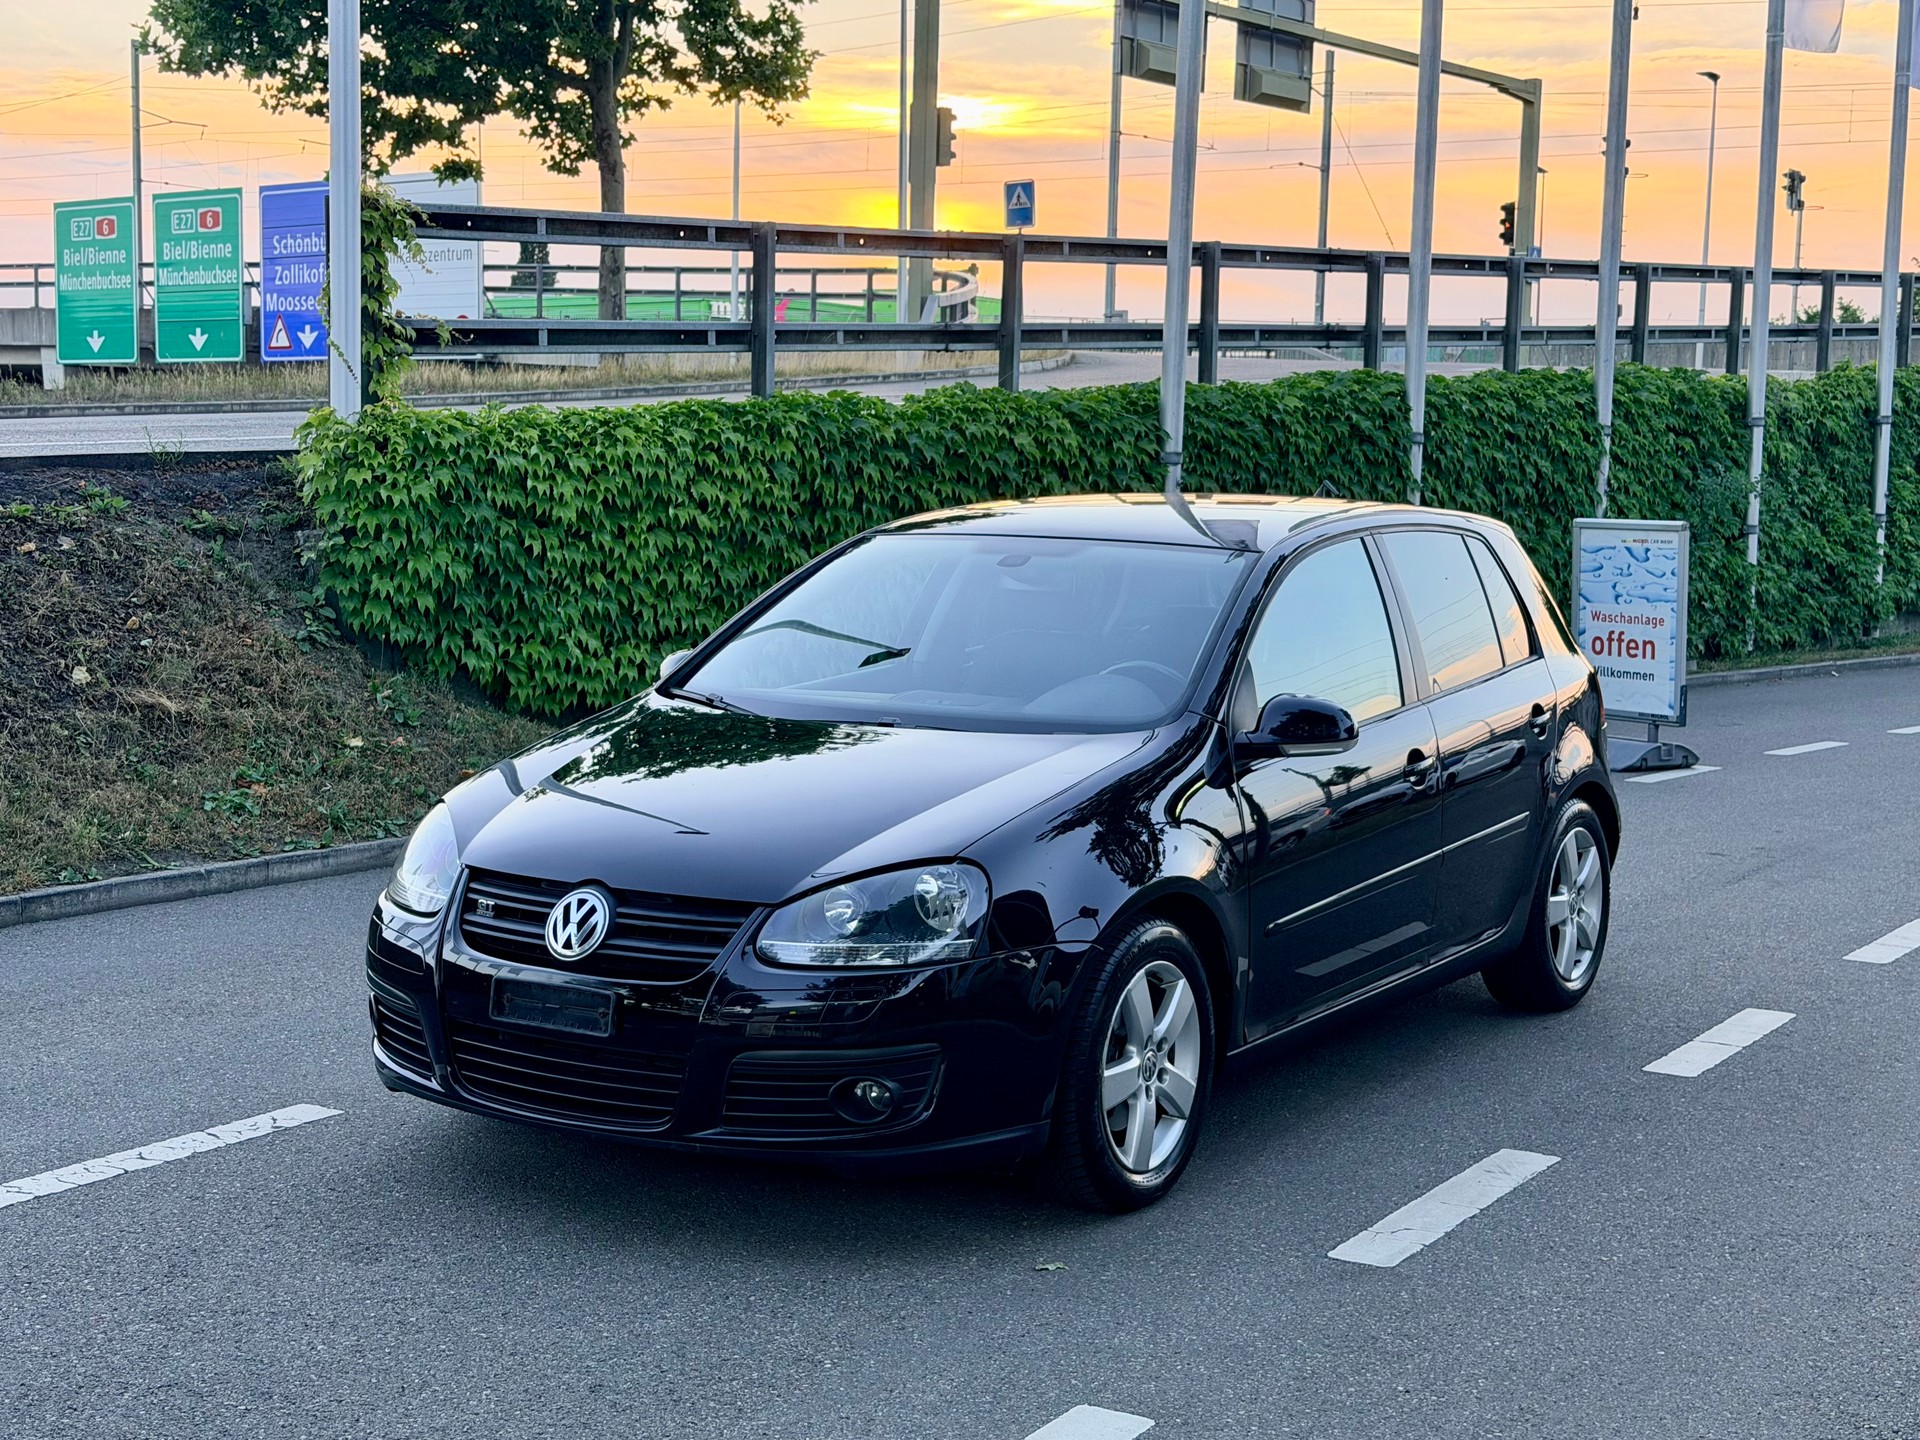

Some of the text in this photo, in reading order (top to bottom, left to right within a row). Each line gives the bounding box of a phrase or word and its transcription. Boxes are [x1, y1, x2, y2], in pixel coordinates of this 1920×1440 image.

[73, 219, 109, 237] E27 6
[173, 212, 213, 229] E27 6
[63, 247, 126, 267] Biel/Bienne
[163, 240, 232, 260] Biel/Bienne
[60, 271, 131, 291] Münchenbuchsee
[158, 265, 238, 286] Münchenbuchsee
[275, 262, 326, 285] Zollikof
[1591, 610, 1665, 629] Waschanlage
[1591, 630, 1656, 660] offen
[478, 899, 495, 912] GT
[547, 891, 607, 958] VW
